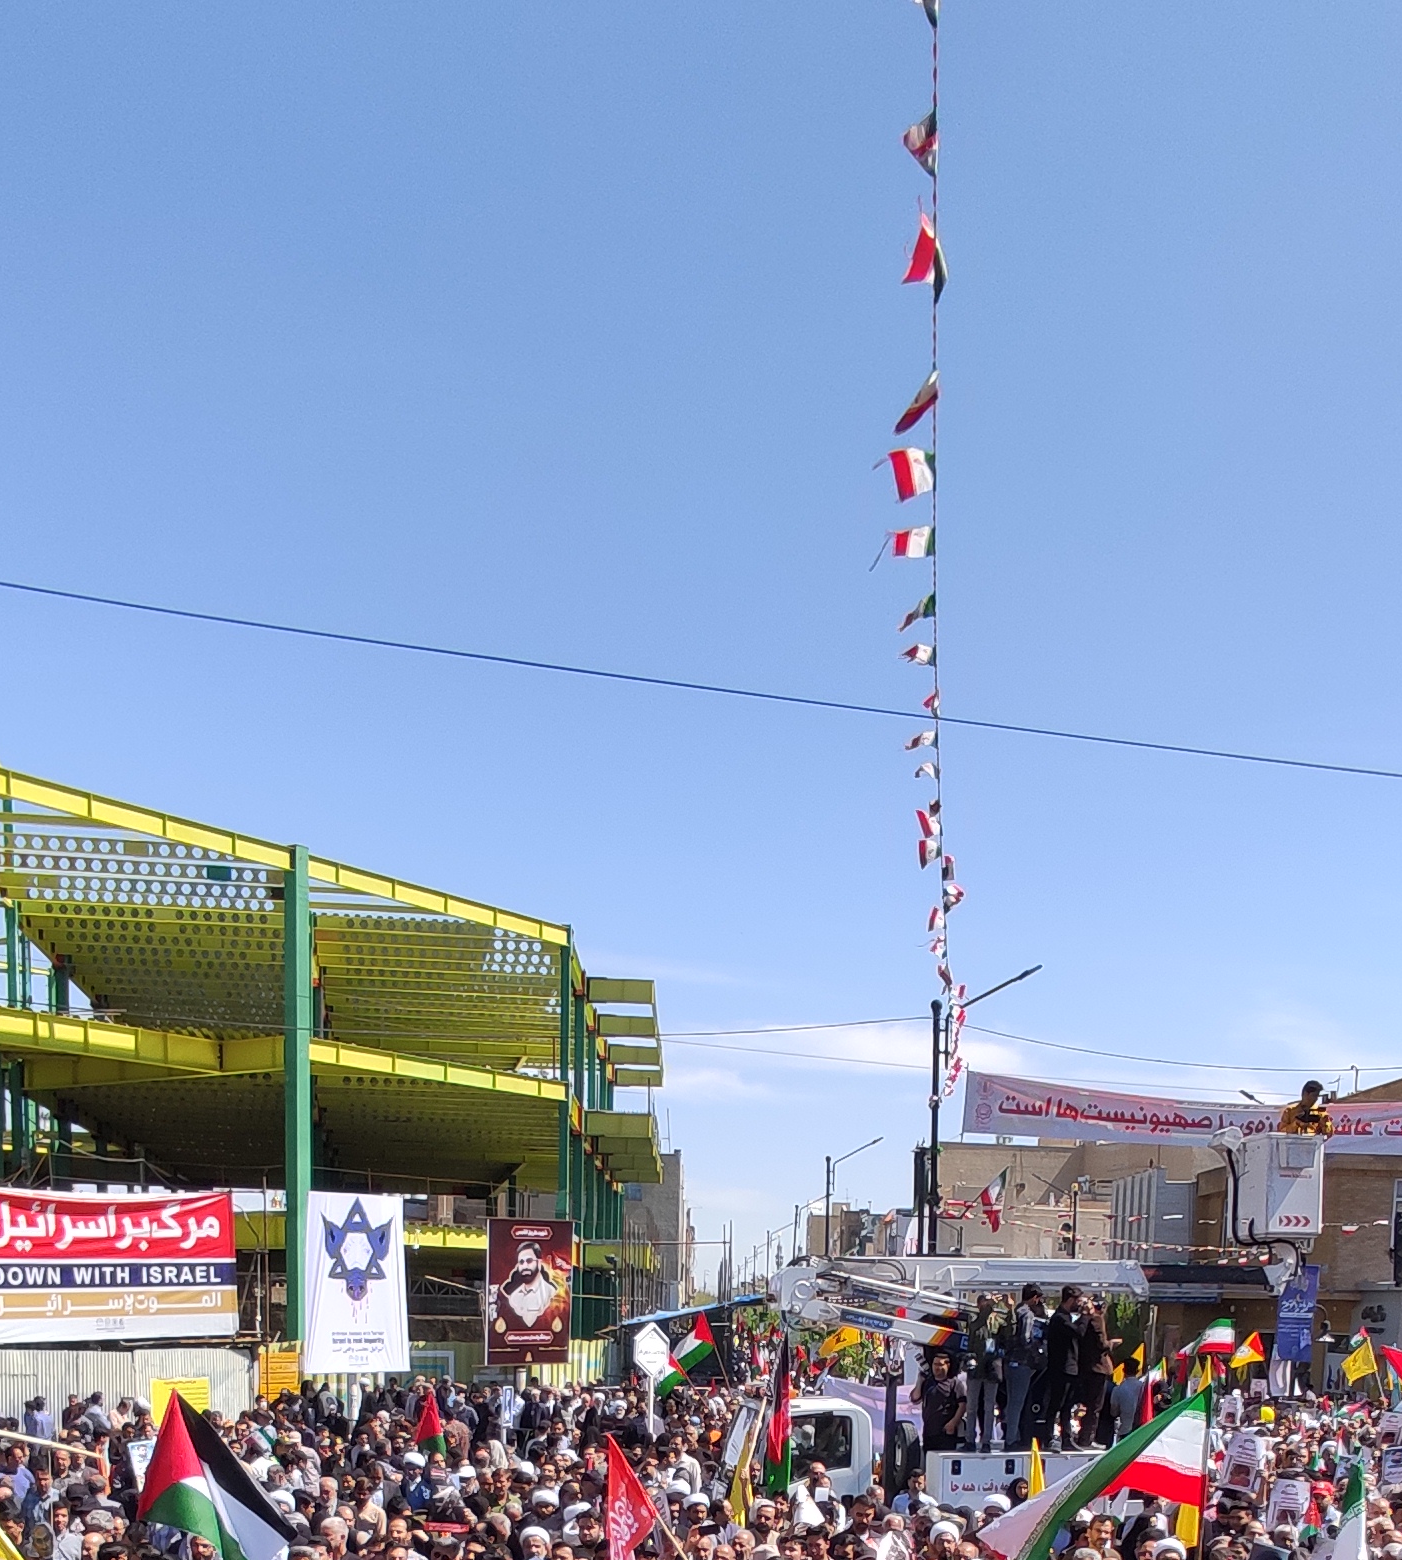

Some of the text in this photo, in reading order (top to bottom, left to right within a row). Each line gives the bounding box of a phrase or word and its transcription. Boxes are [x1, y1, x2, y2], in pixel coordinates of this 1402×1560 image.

[998, 1095, 1053, 1117] است
[115, 1215, 151, 1251] بر
[151, 1201, 220, 1249] مرگ
[73, 1266, 130, 1285] WITH
[142, 1265, 222, 1285] ISRAEL
[135, 1291, 222, 1313] الموت
[950, 1480, 960, 1496] جا
[961, 1482, 976, 1492] همه
[982, 1478, 999, 1493] وقت
